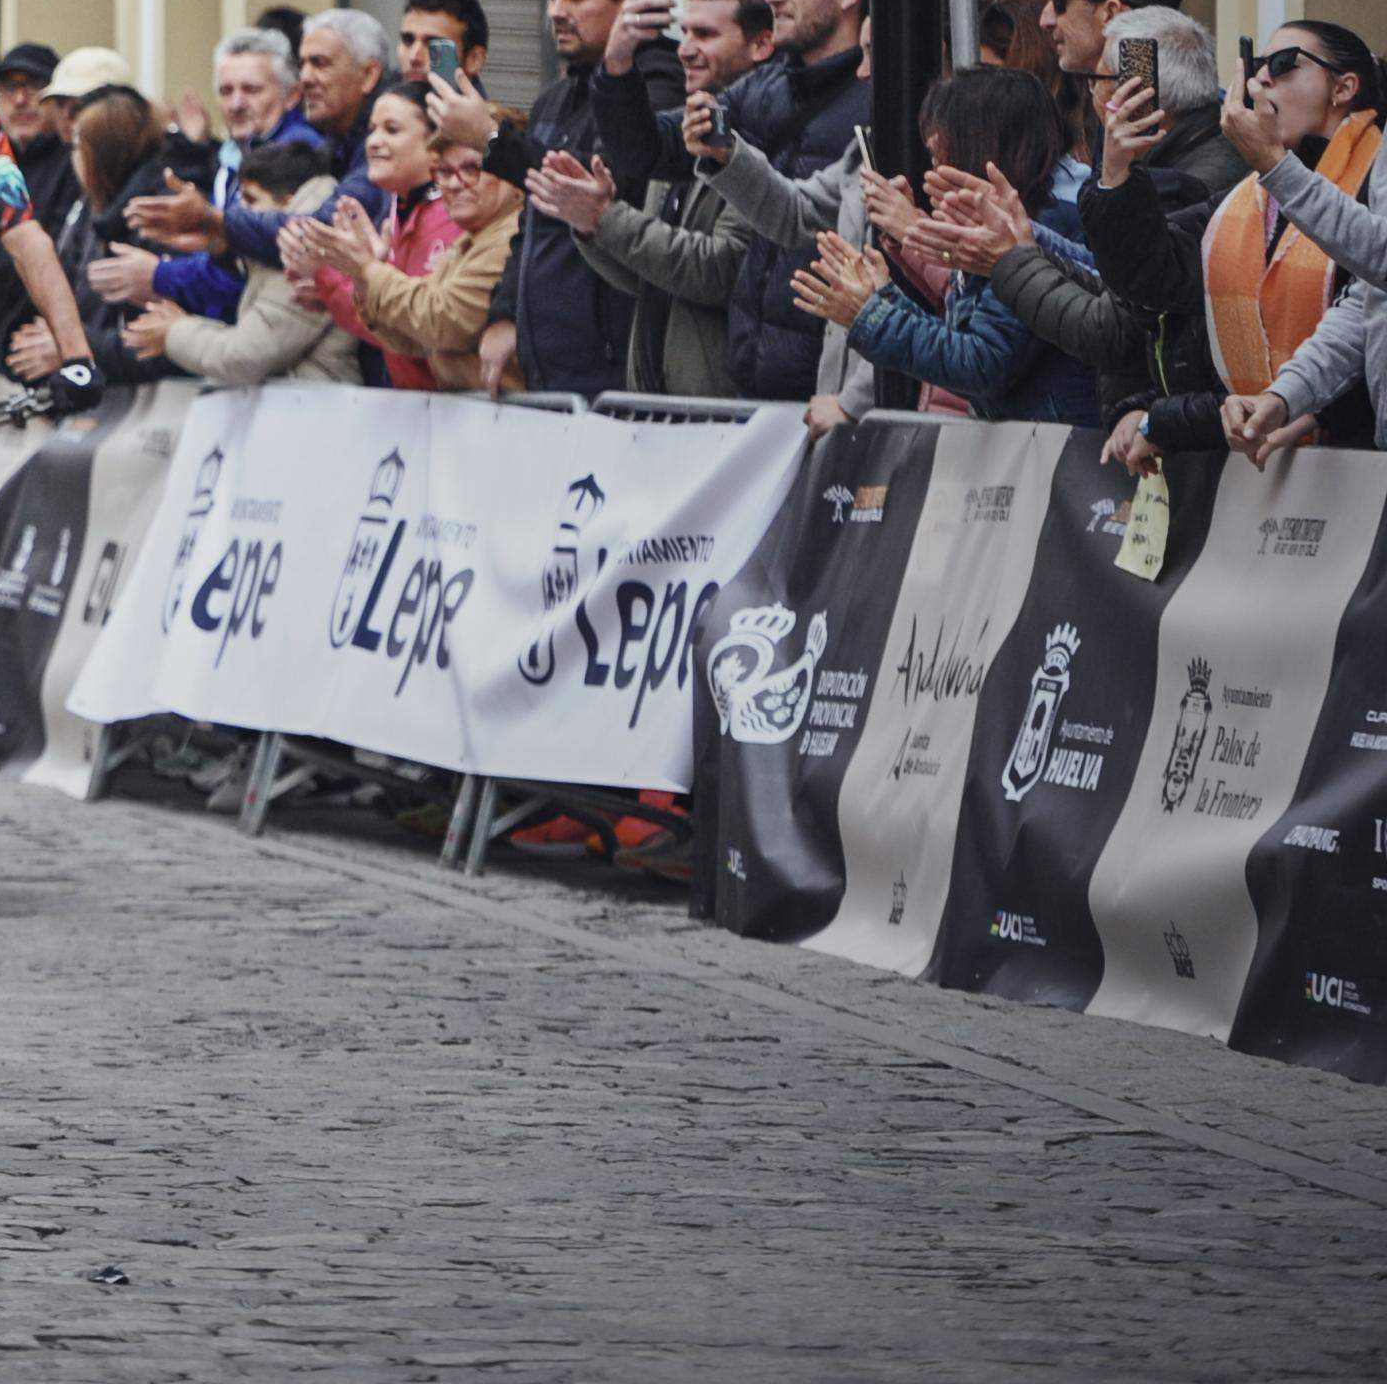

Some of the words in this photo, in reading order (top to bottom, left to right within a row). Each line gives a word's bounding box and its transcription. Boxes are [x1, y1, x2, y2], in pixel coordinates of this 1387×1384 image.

[351, 519, 475, 698] Lepe
[817, 667, 869, 699] DIPUTACIÓN
[809, 699, 859, 729] PROVINCIAL
[1210, 725, 1245, 765] Palos
[1250, 730, 1263, 768] de
[1043, 747, 1104, 792] HUELVA
[1194, 778, 1206, 814] la
[1208, 779, 1264, 821] Frontera
[1312, 972, 1343, 1007] UCI
